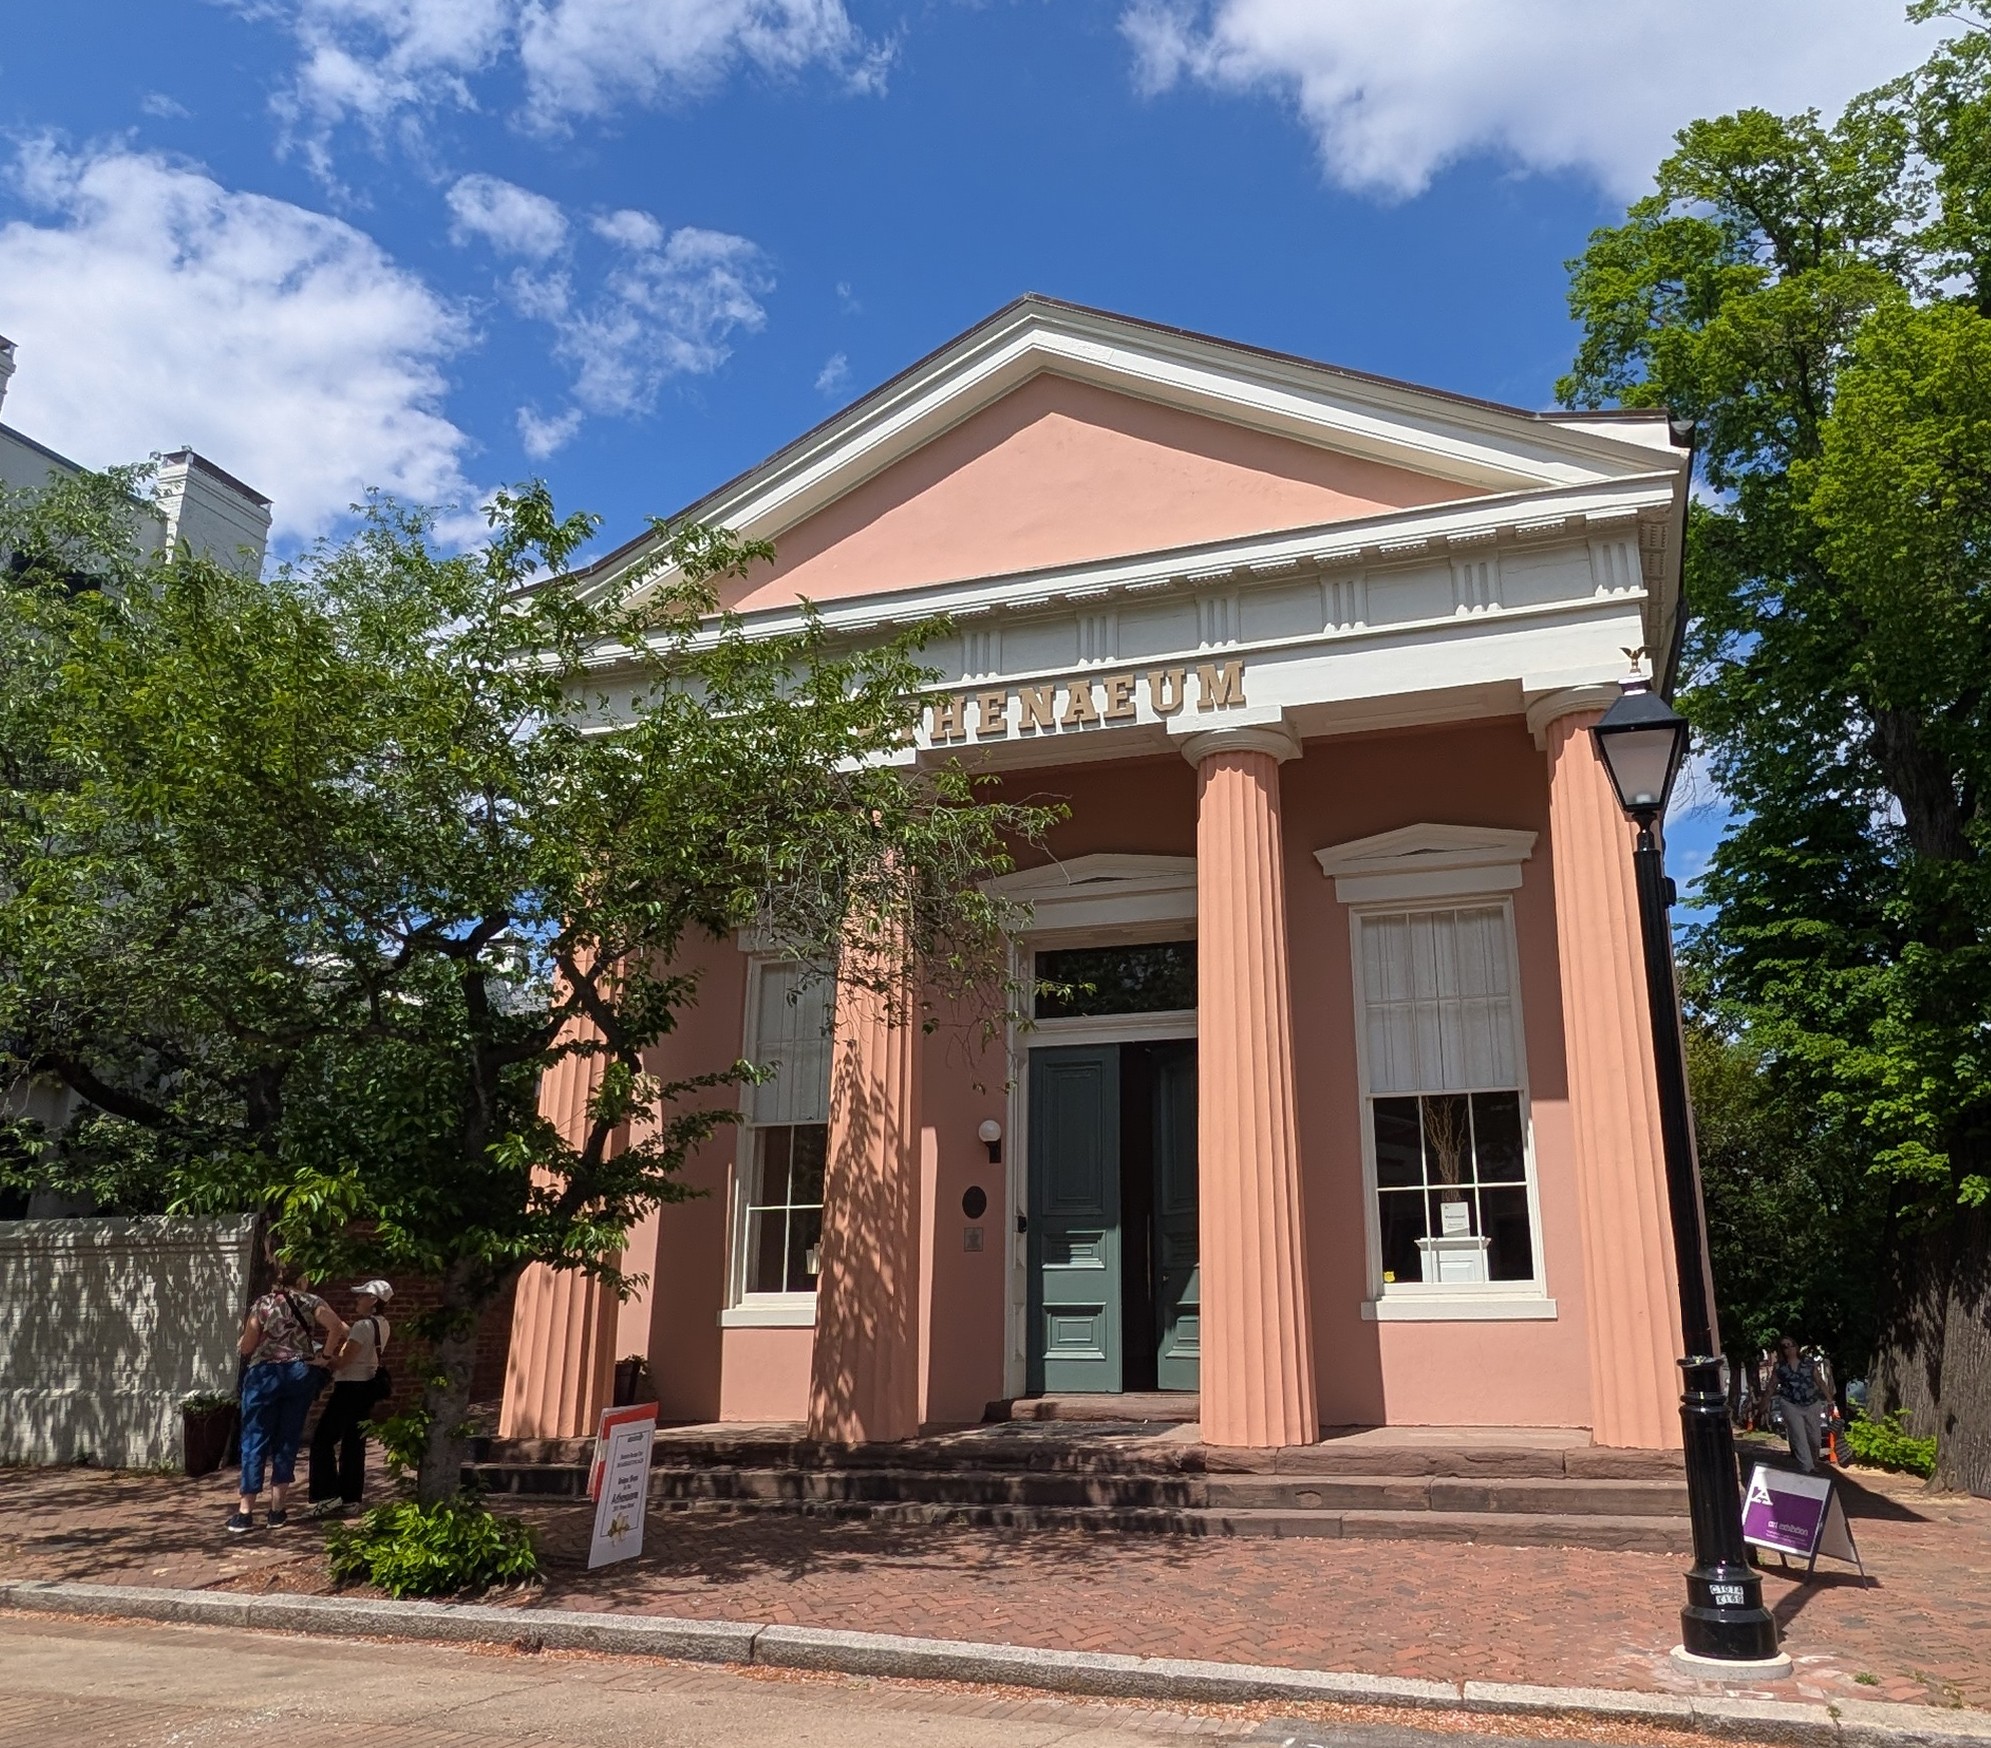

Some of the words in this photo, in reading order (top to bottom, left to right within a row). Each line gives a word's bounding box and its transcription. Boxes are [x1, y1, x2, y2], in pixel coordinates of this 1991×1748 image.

[857, 660, 1246, 744] HENAEUM
[1767, 1520, 1779, 1529] art
[1779, 1523, 1809, 1537] exhibition
